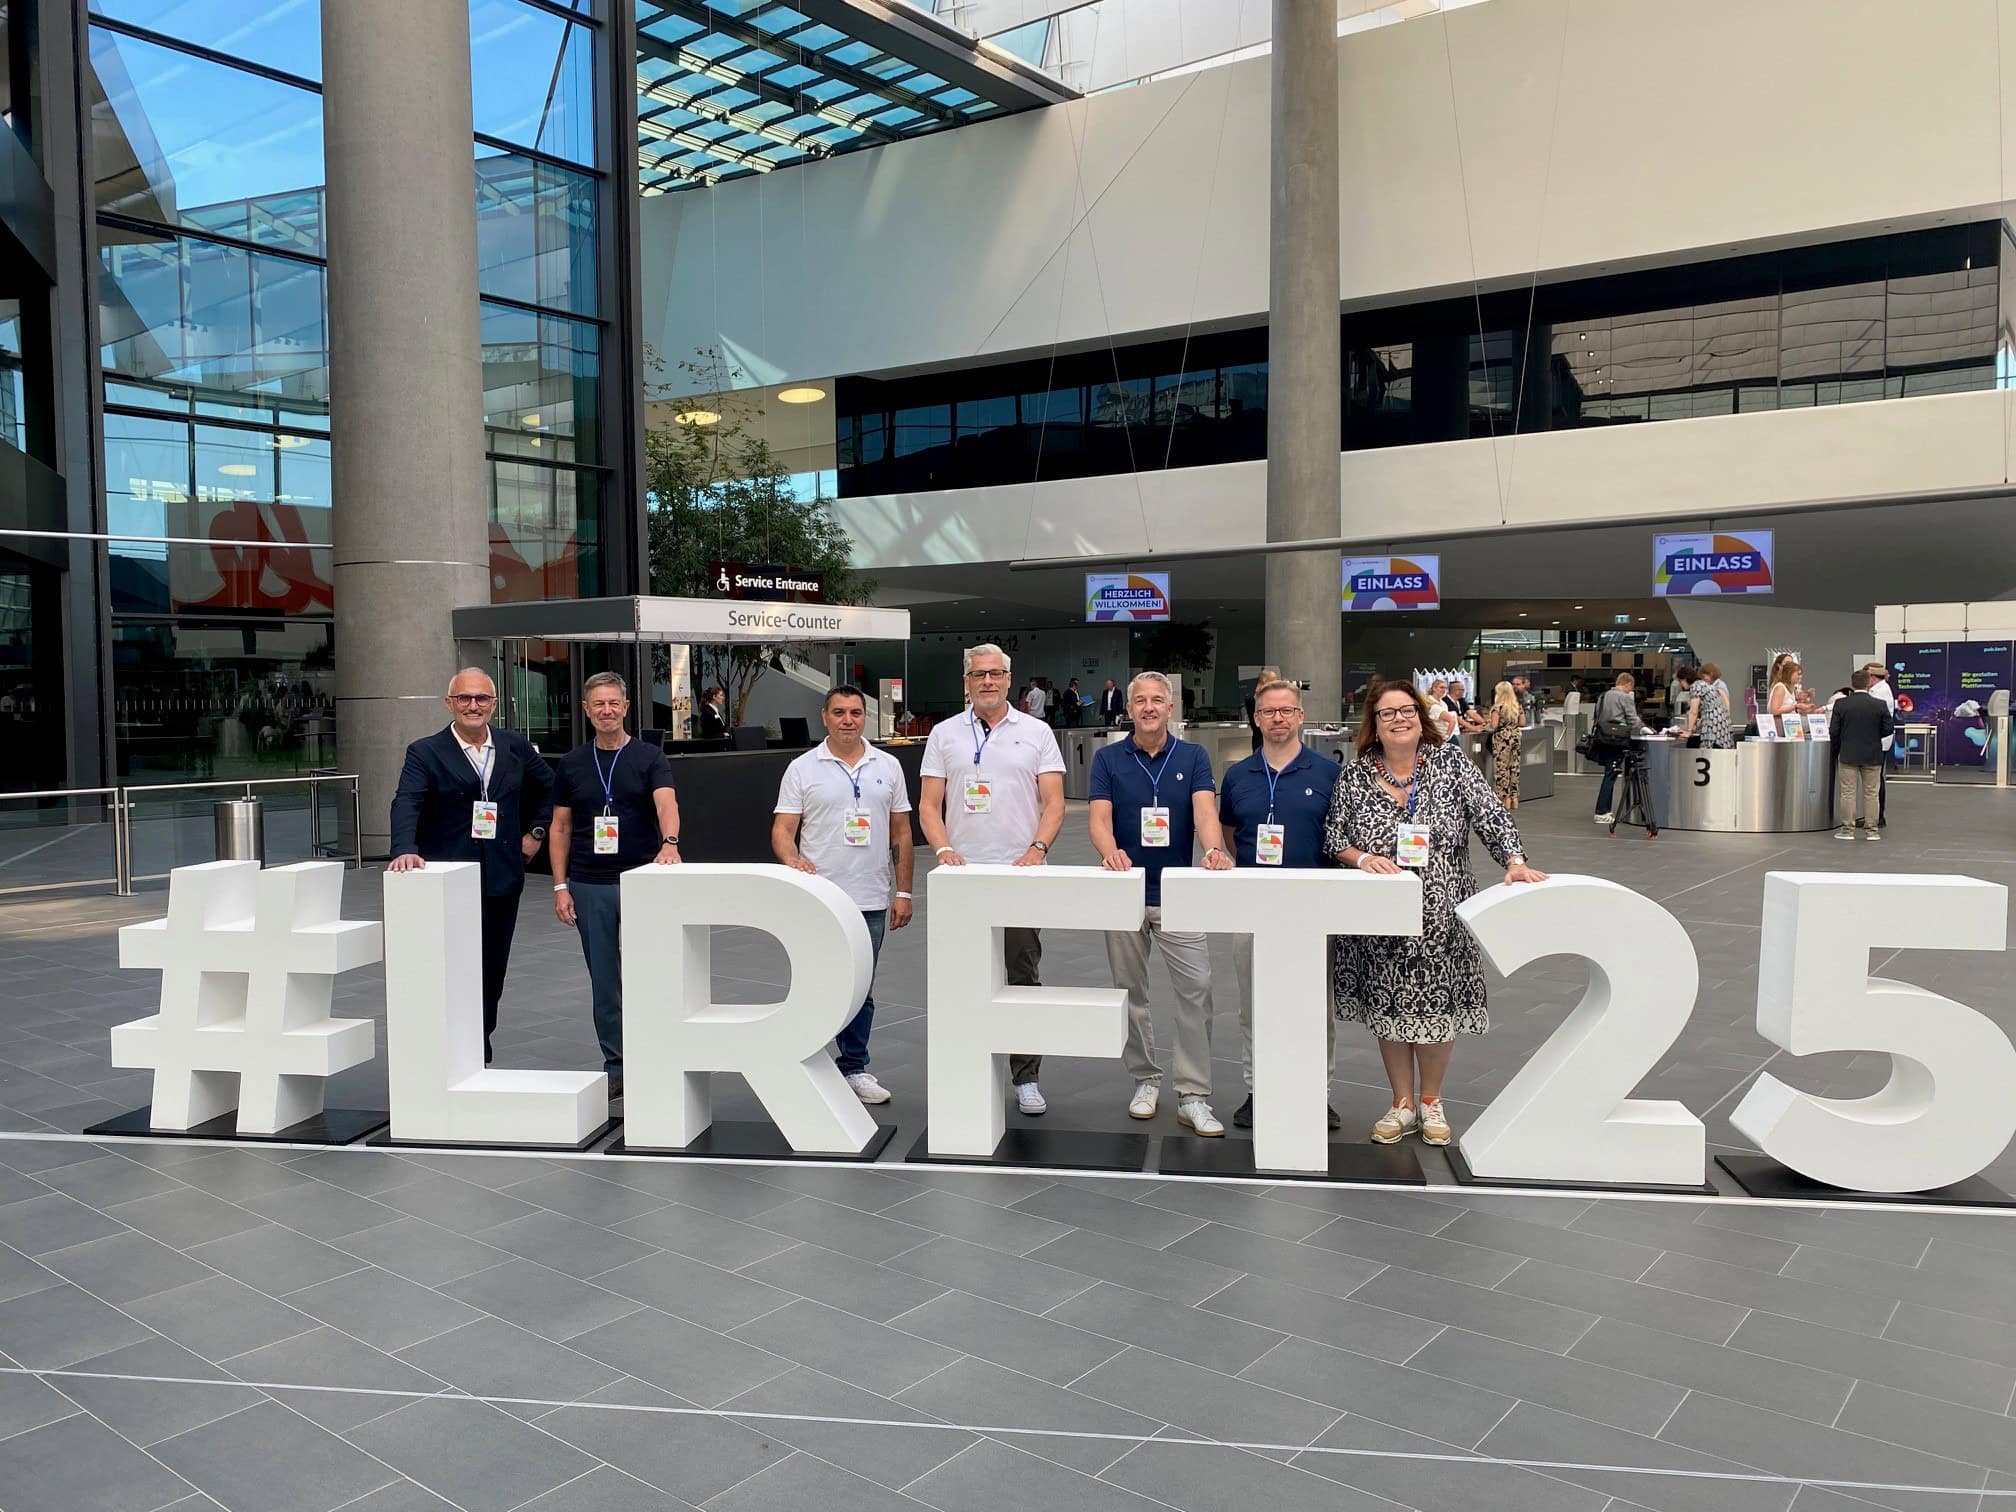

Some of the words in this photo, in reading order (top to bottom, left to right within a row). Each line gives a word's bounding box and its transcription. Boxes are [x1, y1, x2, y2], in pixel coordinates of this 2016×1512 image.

[1674, 555, 1752, 572] EINLASS
[735, 574, 774, 589] Service
[775, 577, 819, 592] Entrance
[1357, 576, 1423, 590] EINLASS
[1104, 589, 1152, 599] HERZLICH
[1095, 599, 1162, 609] WILLKOMMEN!
[728, 610, 842, 630] Service-Counter
[1076, 743, 1084, 765] 1
[1693, 757, 1711, 787] 3
[110, 859, 2016, 1194] #LRFT25
